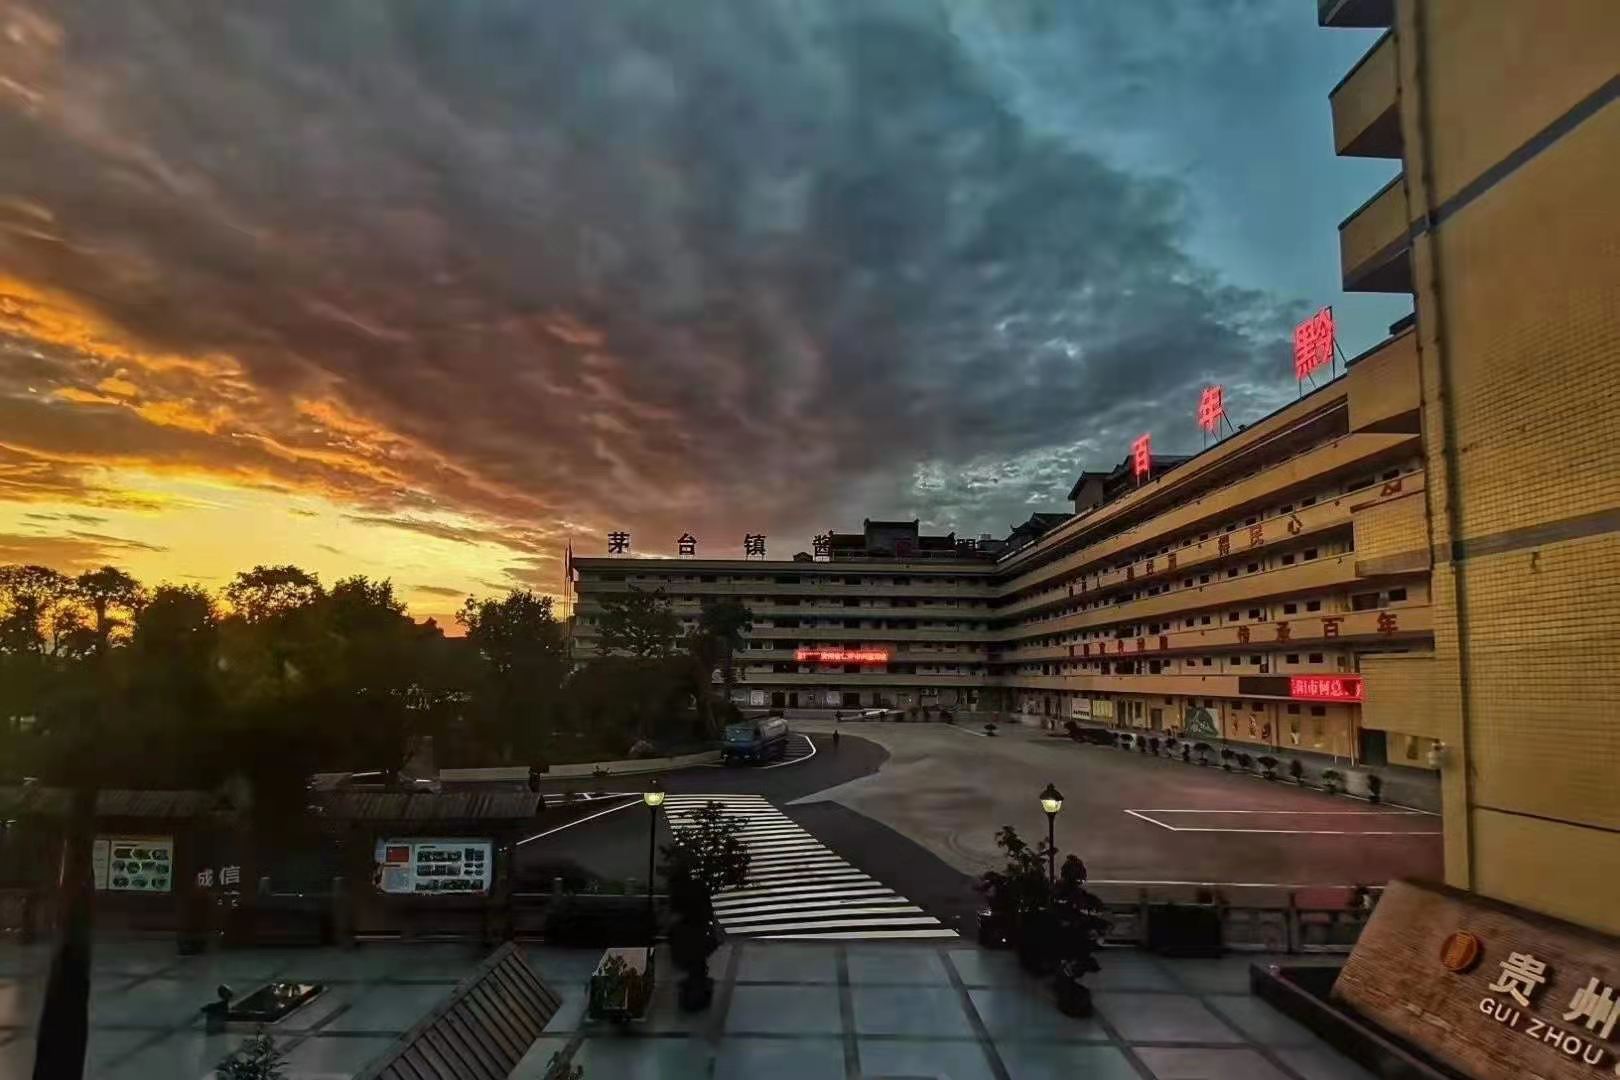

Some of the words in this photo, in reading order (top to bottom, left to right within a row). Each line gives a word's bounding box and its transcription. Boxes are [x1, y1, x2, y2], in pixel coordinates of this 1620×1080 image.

[1479, 997, 1520, 1028] GUI
[1525, 1017, 1604, 1065] ZHOU
[1489, 951, 1620, 1039] 贵州
